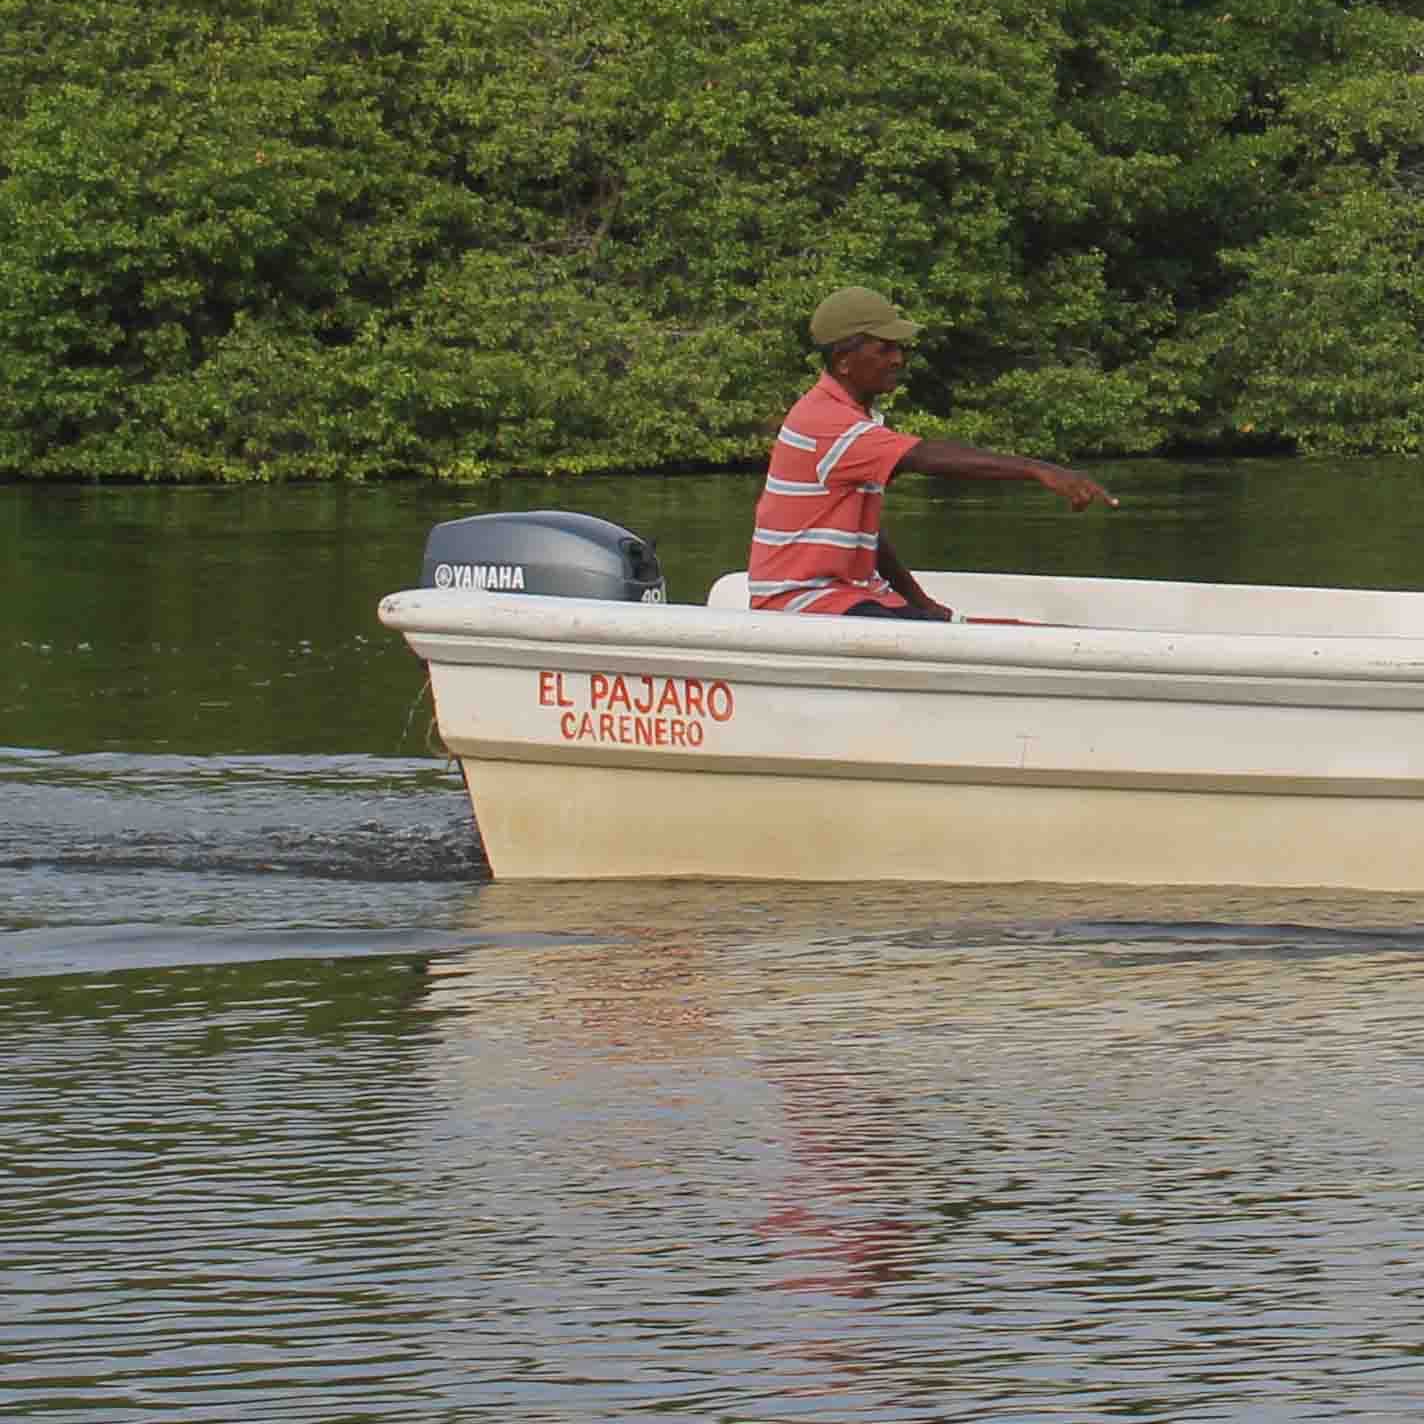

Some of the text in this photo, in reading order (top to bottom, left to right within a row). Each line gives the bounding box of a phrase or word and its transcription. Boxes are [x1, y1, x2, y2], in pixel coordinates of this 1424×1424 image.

[453, 565, 525, 590] YAMAHA
[539, 672, 734, 721] EL PAJARO
[561, 711, 704, 746] CARENERO
